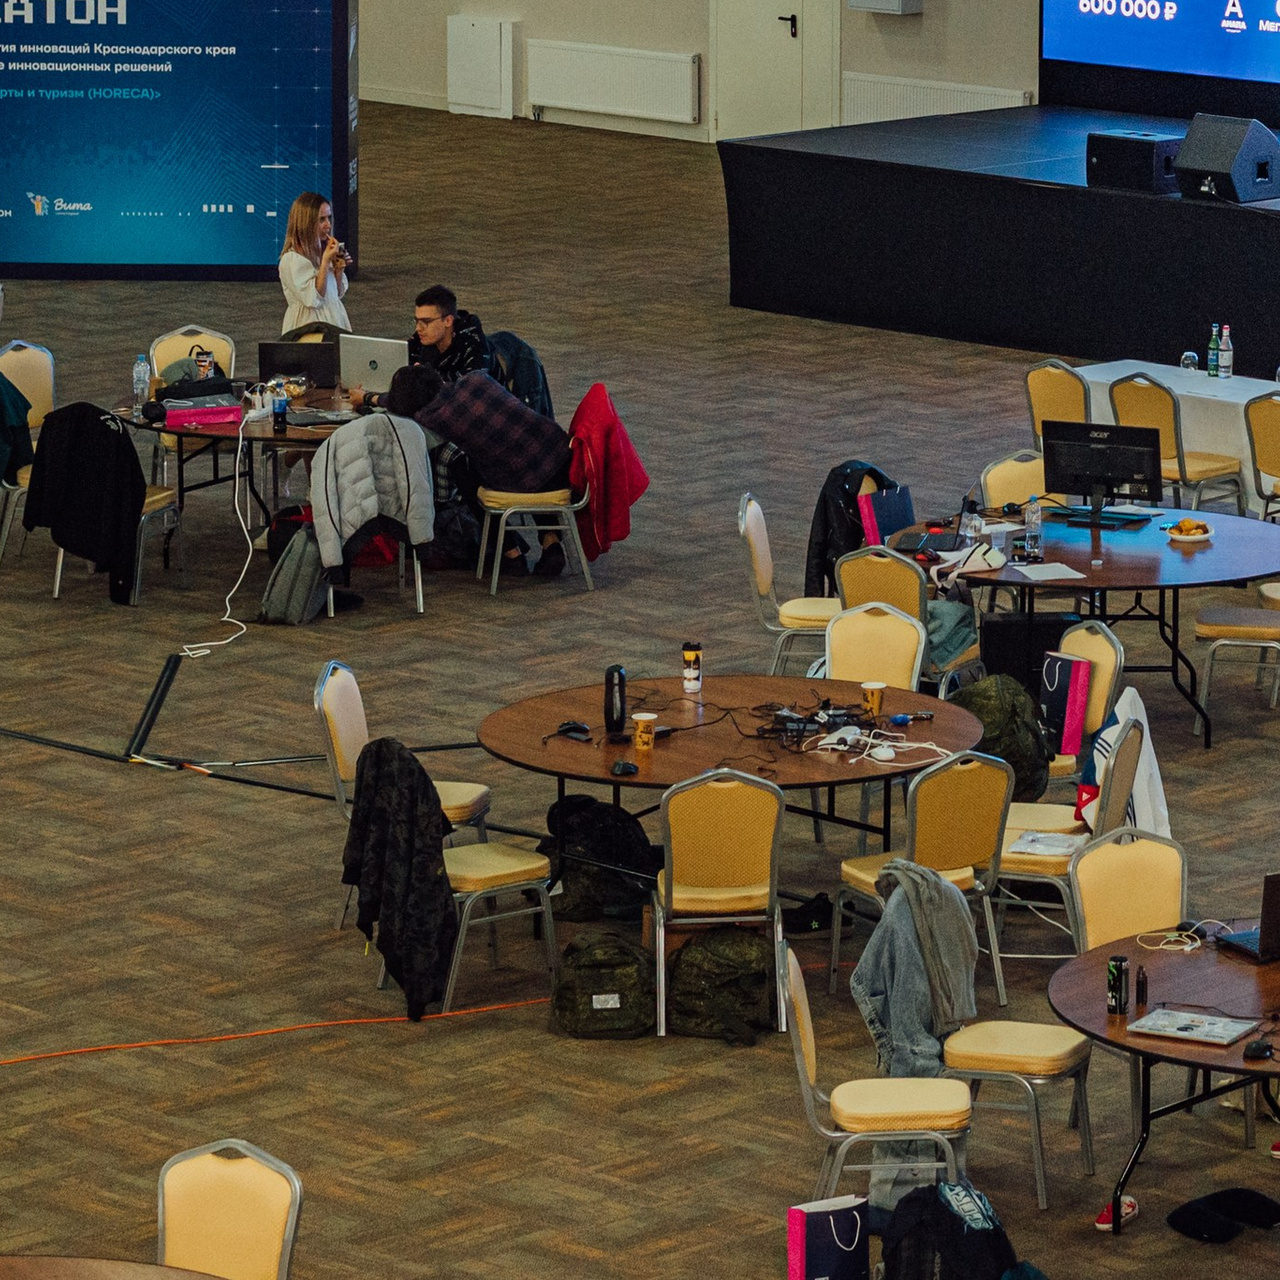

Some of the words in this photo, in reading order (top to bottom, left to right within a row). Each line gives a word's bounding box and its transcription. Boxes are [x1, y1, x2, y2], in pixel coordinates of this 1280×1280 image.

[20, 43, 90, 55] инноваций
[94, 44, 202, 56] Краснодарского
[205, 46, 236, 56] края
[8, 62, 111, 72] инновационных
[114, 61, 172, 74] решений
[27, 90, 35, 98] и
[38, 89, 84, 99] туризм
[88, 88, 161, 100] (HORECA)>
[53, 198, 93, 211] Вита
